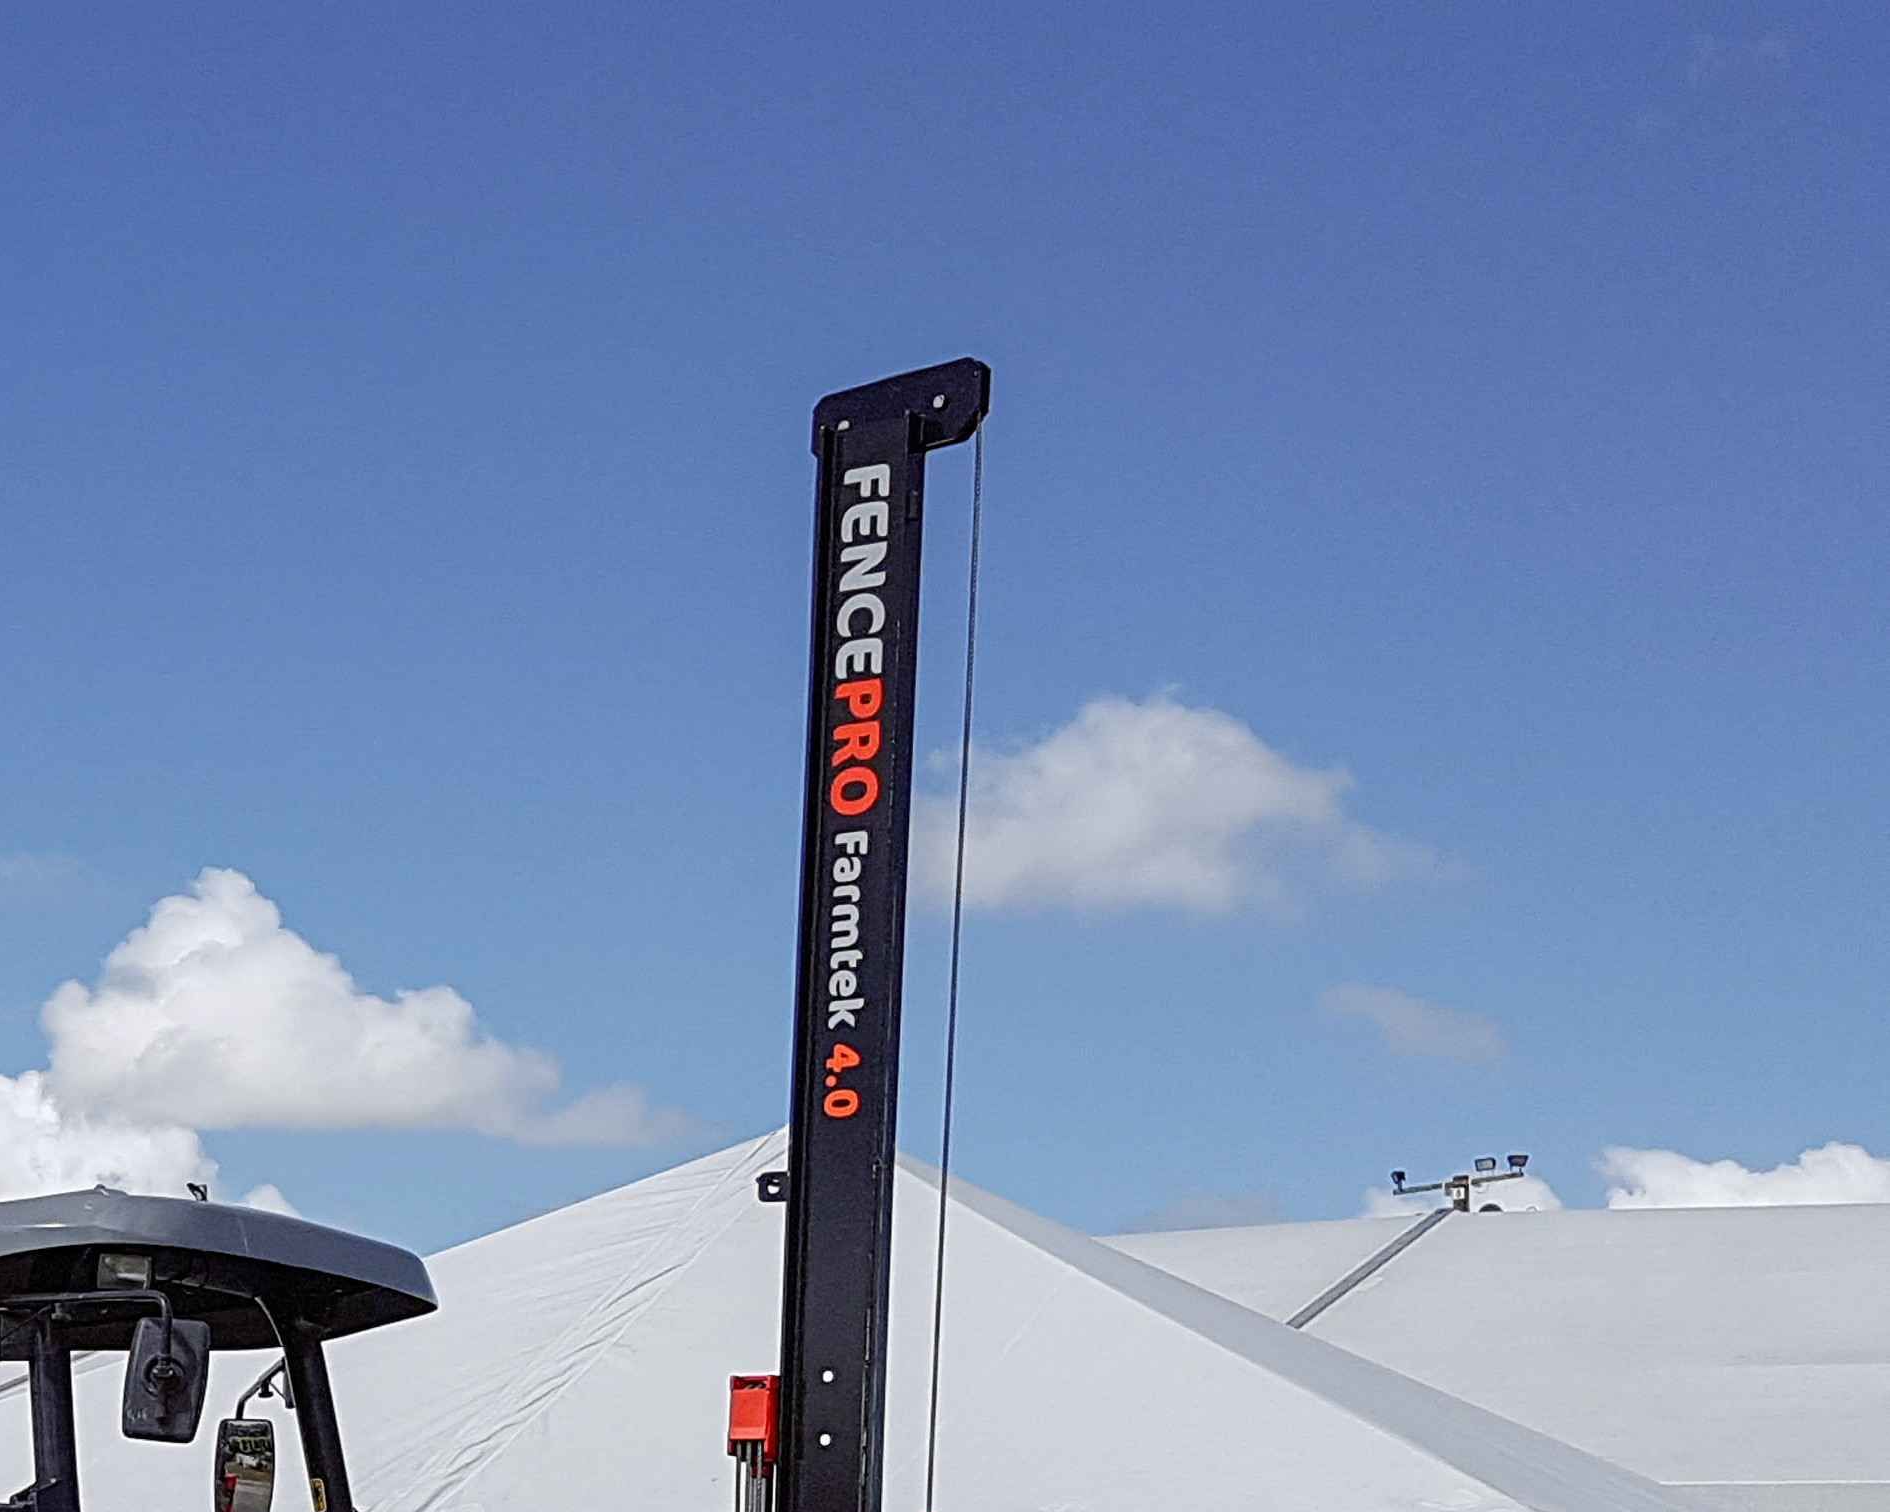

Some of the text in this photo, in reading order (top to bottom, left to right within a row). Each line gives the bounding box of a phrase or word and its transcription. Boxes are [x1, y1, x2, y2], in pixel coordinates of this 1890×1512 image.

[823, 463, 891, 1118] FENCEPRO Farmtek 4.0
